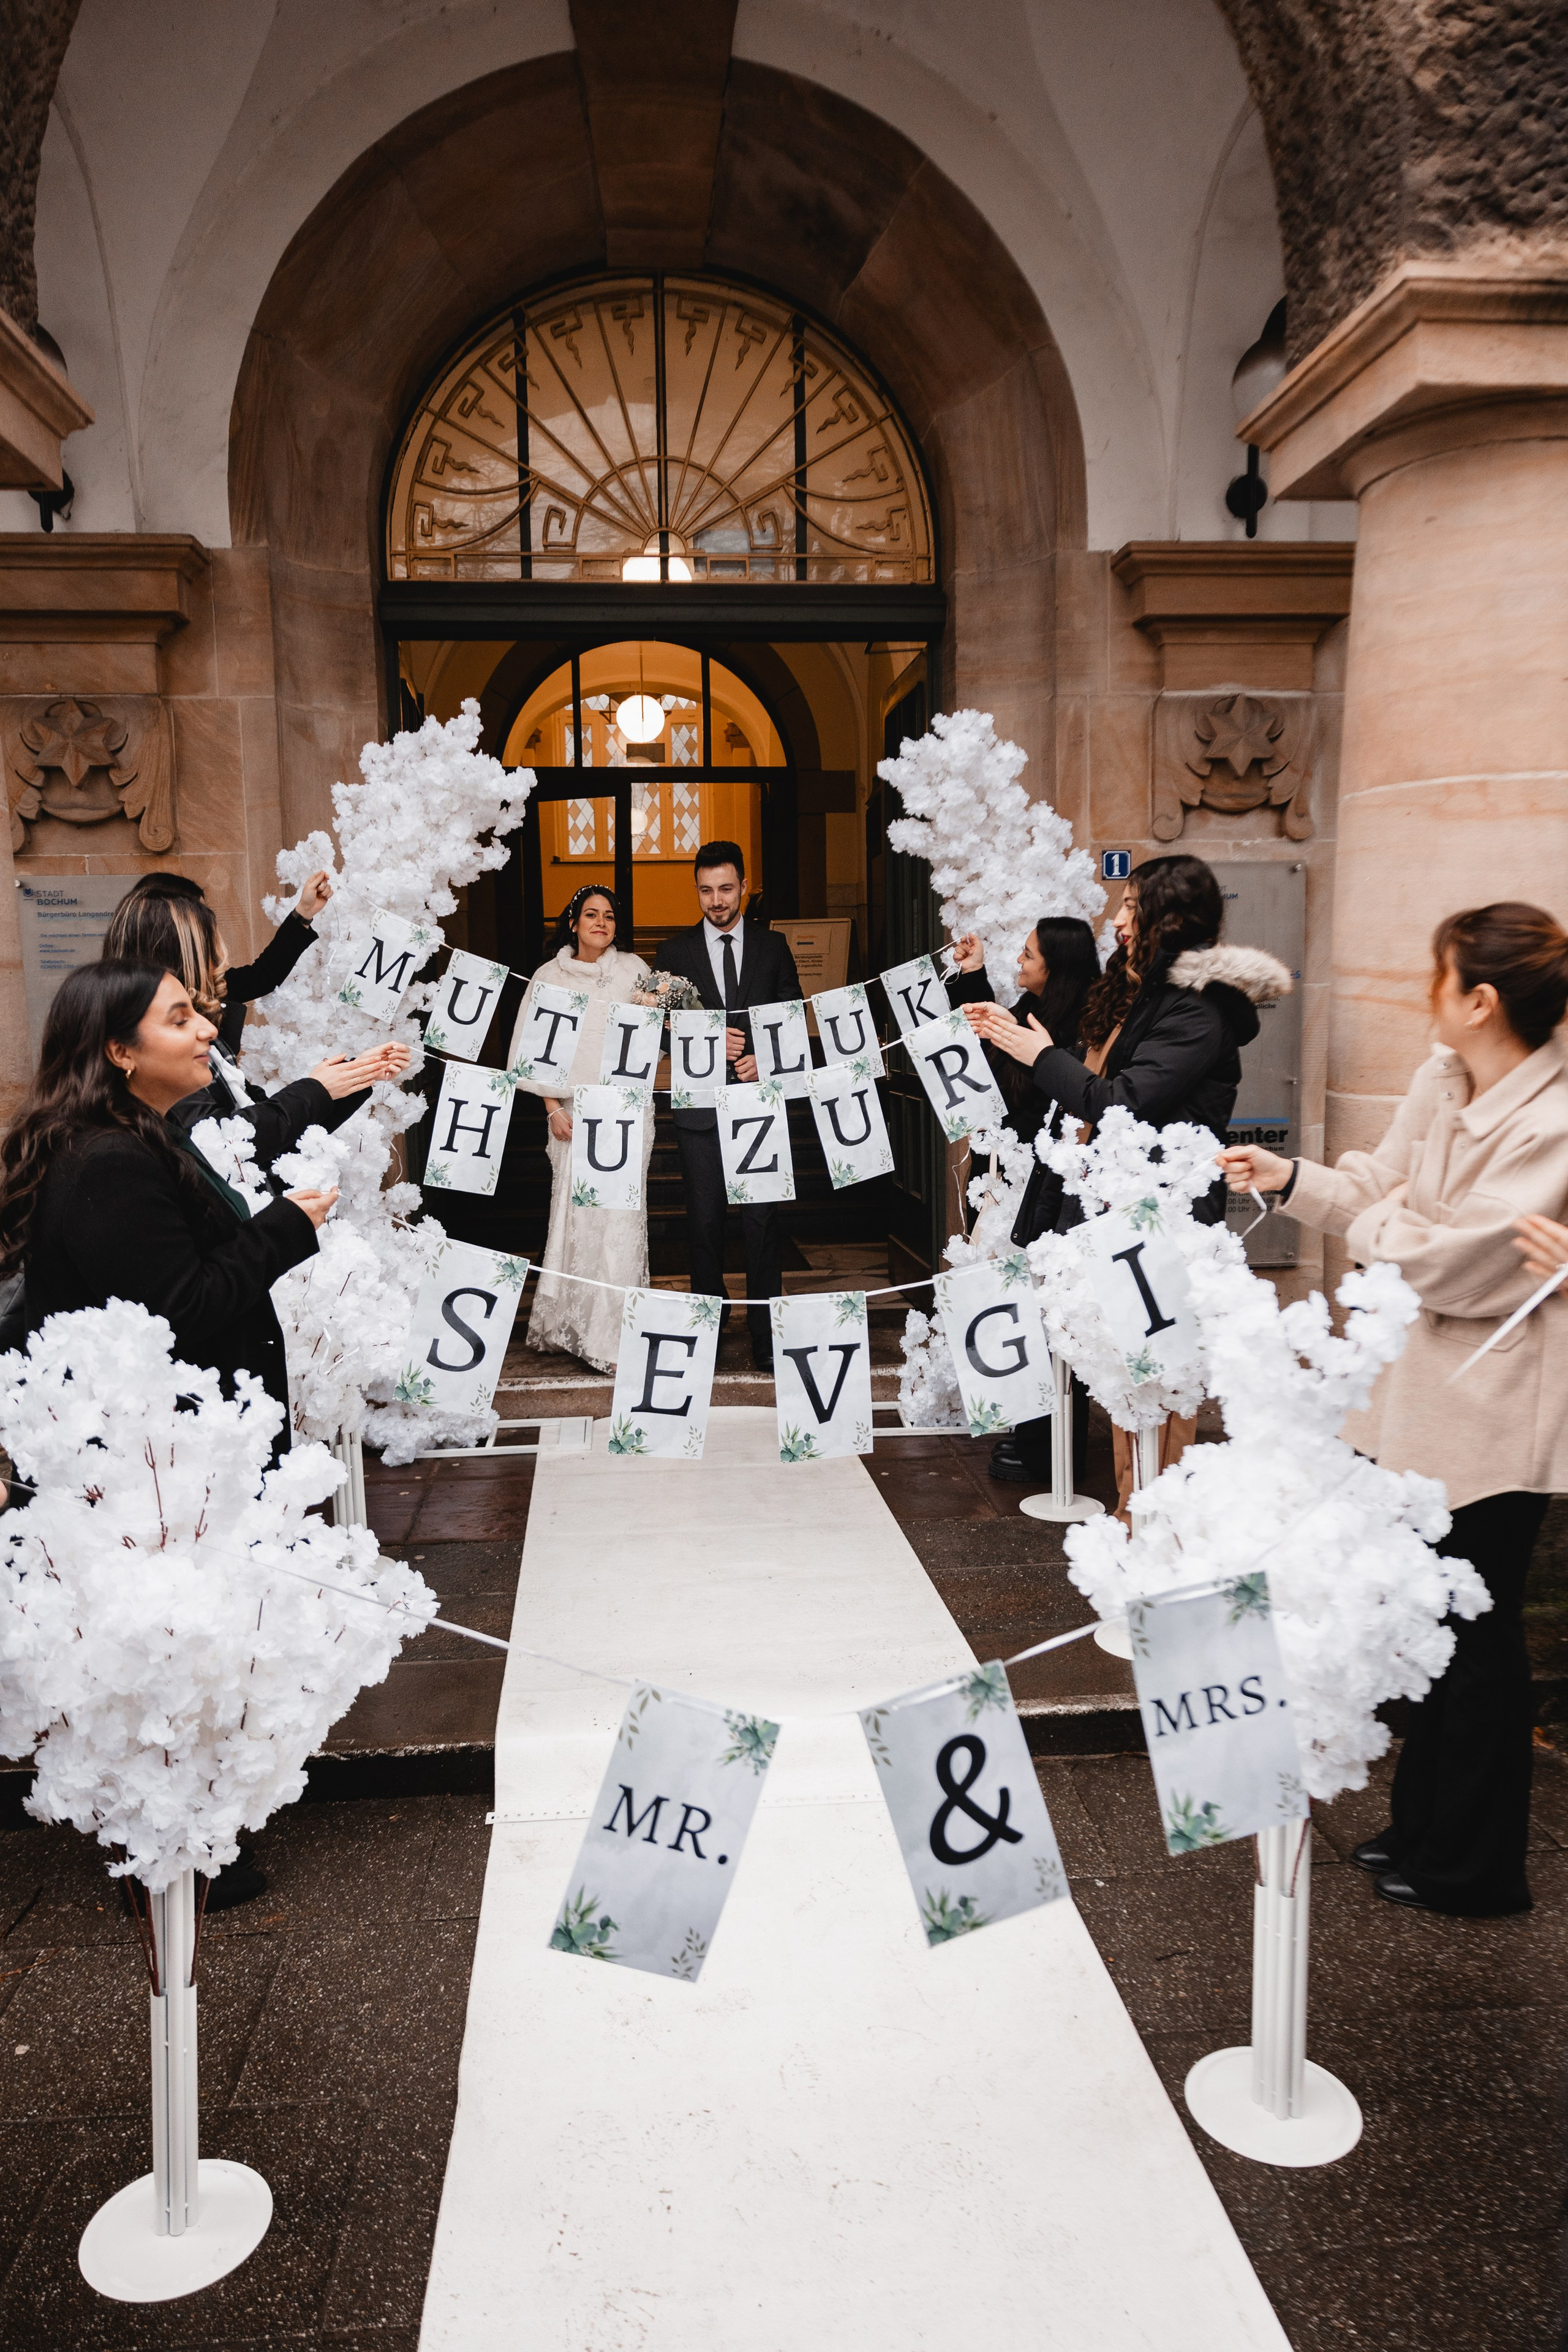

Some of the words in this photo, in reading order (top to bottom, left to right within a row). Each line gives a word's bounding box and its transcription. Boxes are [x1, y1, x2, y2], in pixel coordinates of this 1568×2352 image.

[1111, 854, 1121, 876] 1
[439, 1044, 992, 1175] HUZUR
[1227, 1126, 1288, 1144] enter
[603, 1783, 729, 1865] MR.
[930, 1734, 1024, 1866] &
[1150, 1675, 1288, 1738] MRS.
